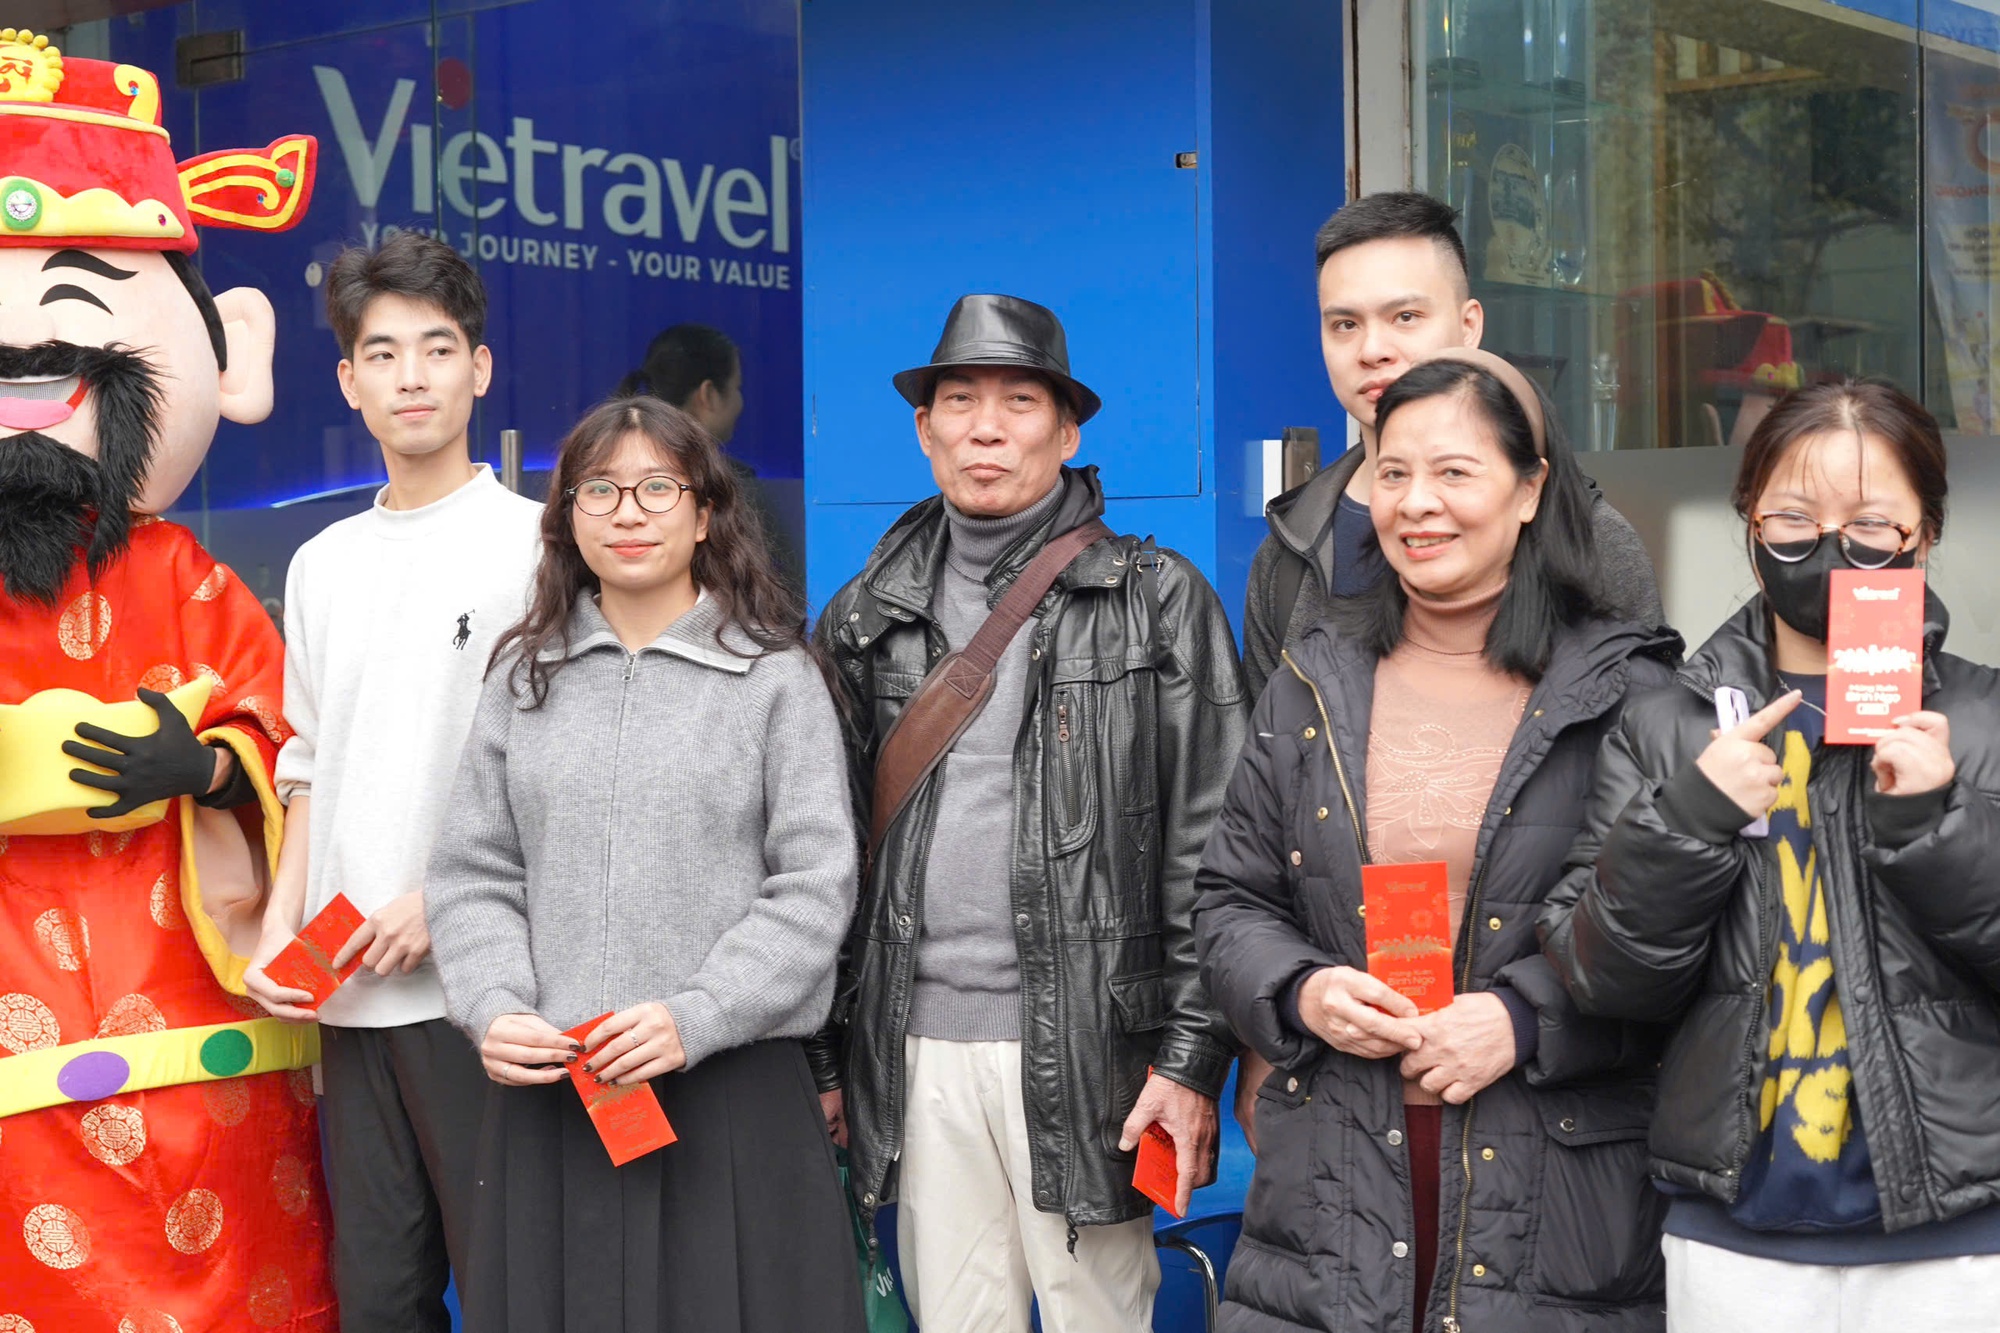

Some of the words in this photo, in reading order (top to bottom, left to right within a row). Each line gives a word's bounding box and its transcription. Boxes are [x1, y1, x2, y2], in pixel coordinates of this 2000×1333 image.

[312, 62, 790, 253] Vietravel
[460, 232, 598, 271] JOURNEY
[627, 249, 700, 281] YOUR
[709, 258, 790, 290] VALUE
